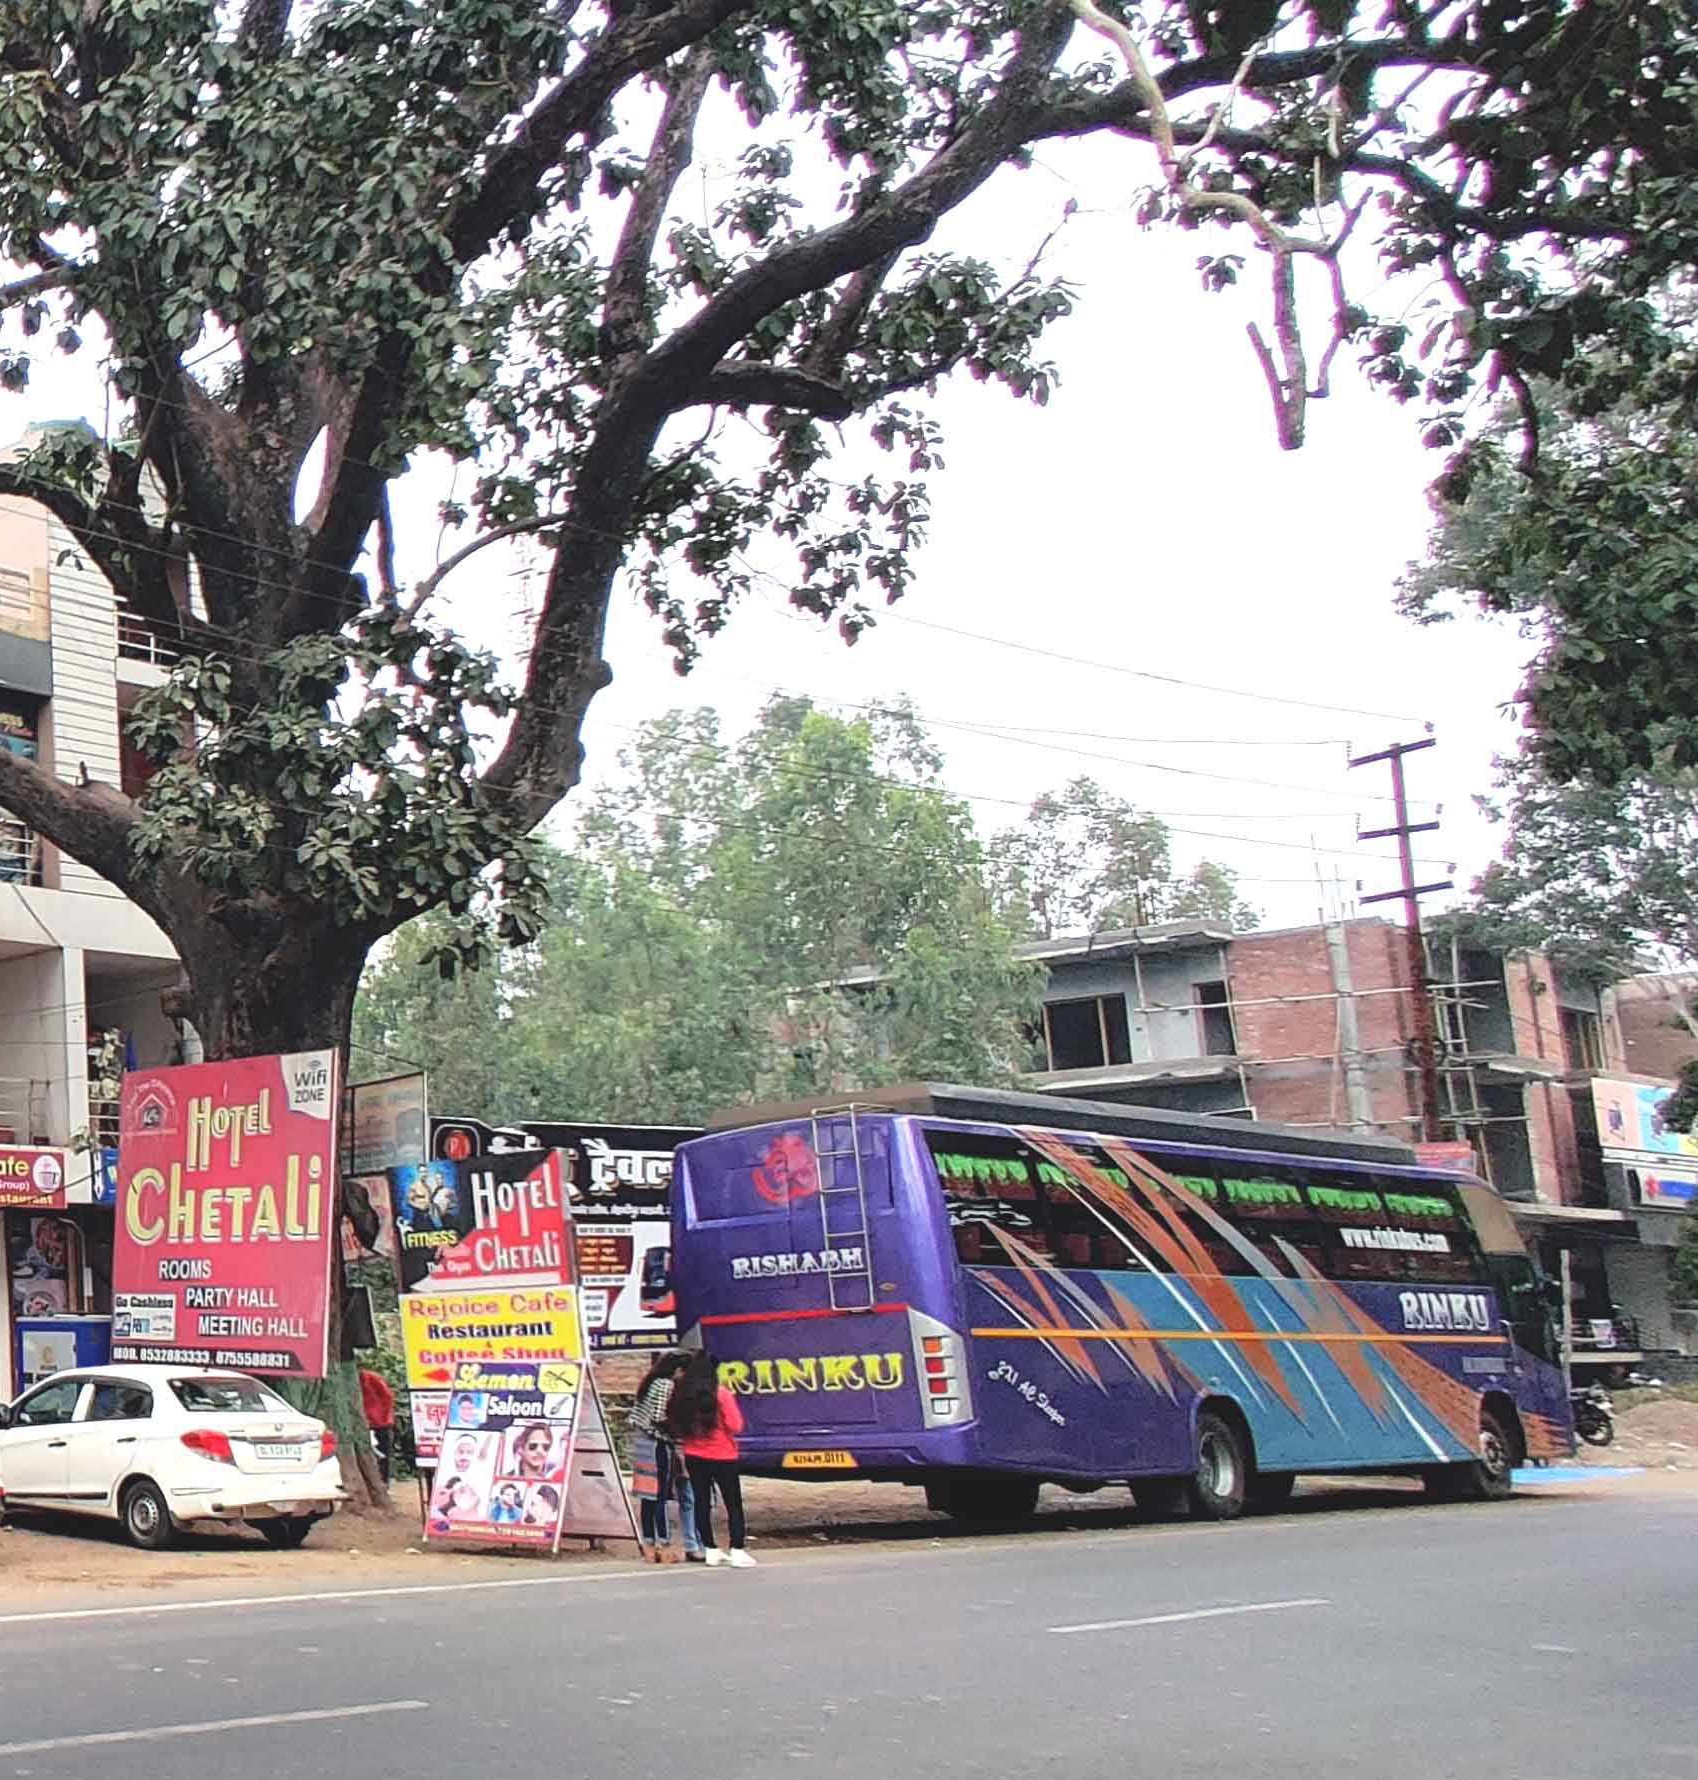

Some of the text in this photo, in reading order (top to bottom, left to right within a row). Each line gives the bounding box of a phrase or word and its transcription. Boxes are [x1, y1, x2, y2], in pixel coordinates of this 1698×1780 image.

[294, 1069, 328, 1086] Wifi
[294, 1086, 326, 1104] ZONE
[187, 1088, 272, 1172] HOTEL
[470, 1163, 558, 1238] HOTEL
[407, 1230, 457, 1249] FITNESS
[158, 1259, 213, 1281] ROOMS
[732, 1248, 865, 1279] RISHABH
[185, 1286, 279, 1309] PARTY HALL
[408, 1297, 499, 1321] Rejoice
[509, 1292, 569, 1314] Cafe
[1398, 1291, 1491, 1332] RINKU
[198, 1314, 263, 1337] MEETING
[267, 1316, 309, 1339] HALL
[428, 1320, 552, 1341] Restaurant
[716, 1352, 903, 1396] RINKU
[488, 1395, 545, 1418] Saloon
